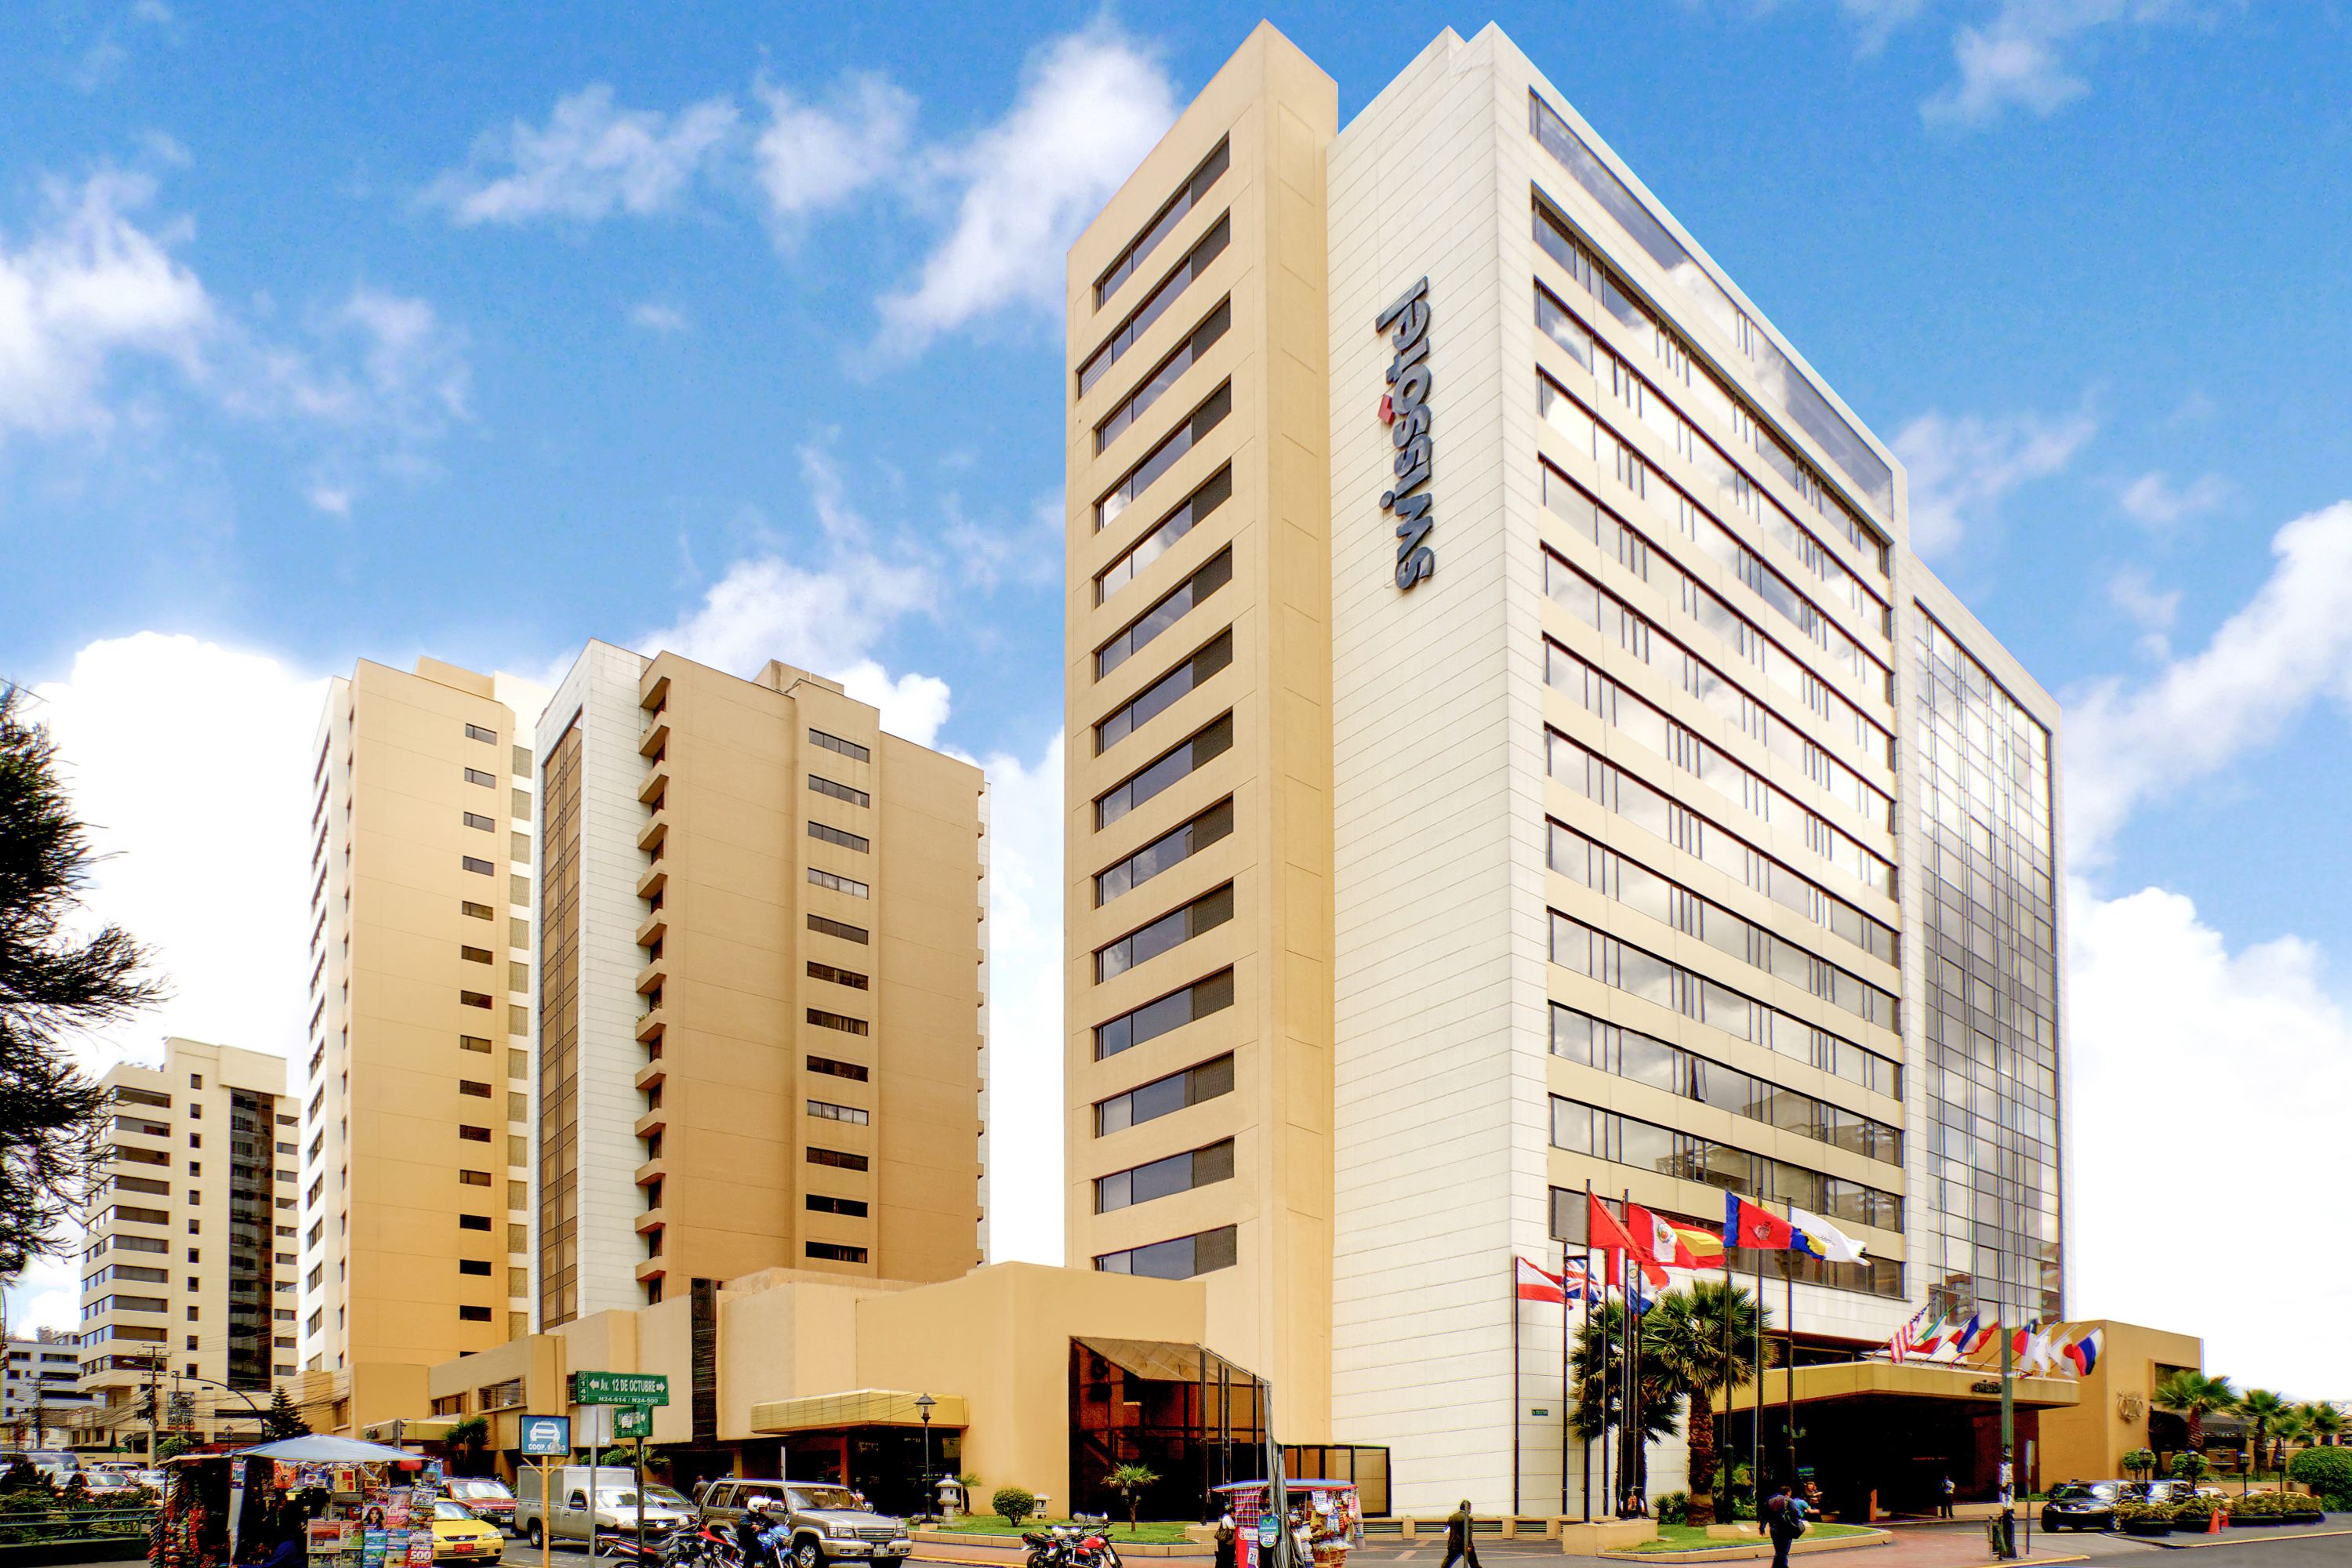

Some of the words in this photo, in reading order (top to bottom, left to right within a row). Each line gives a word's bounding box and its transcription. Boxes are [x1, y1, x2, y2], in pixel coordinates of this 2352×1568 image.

[1375, 275, 1434, 590] swissôtel
[600, 1378, 609, 1391] Av.
[612, 1378, 619, 1392] 12
[620, 1379, 629, 1392] DE
[629, 1379, 656, 1393] OCTUBRE
[410, 1550, 432, 1560] 500
